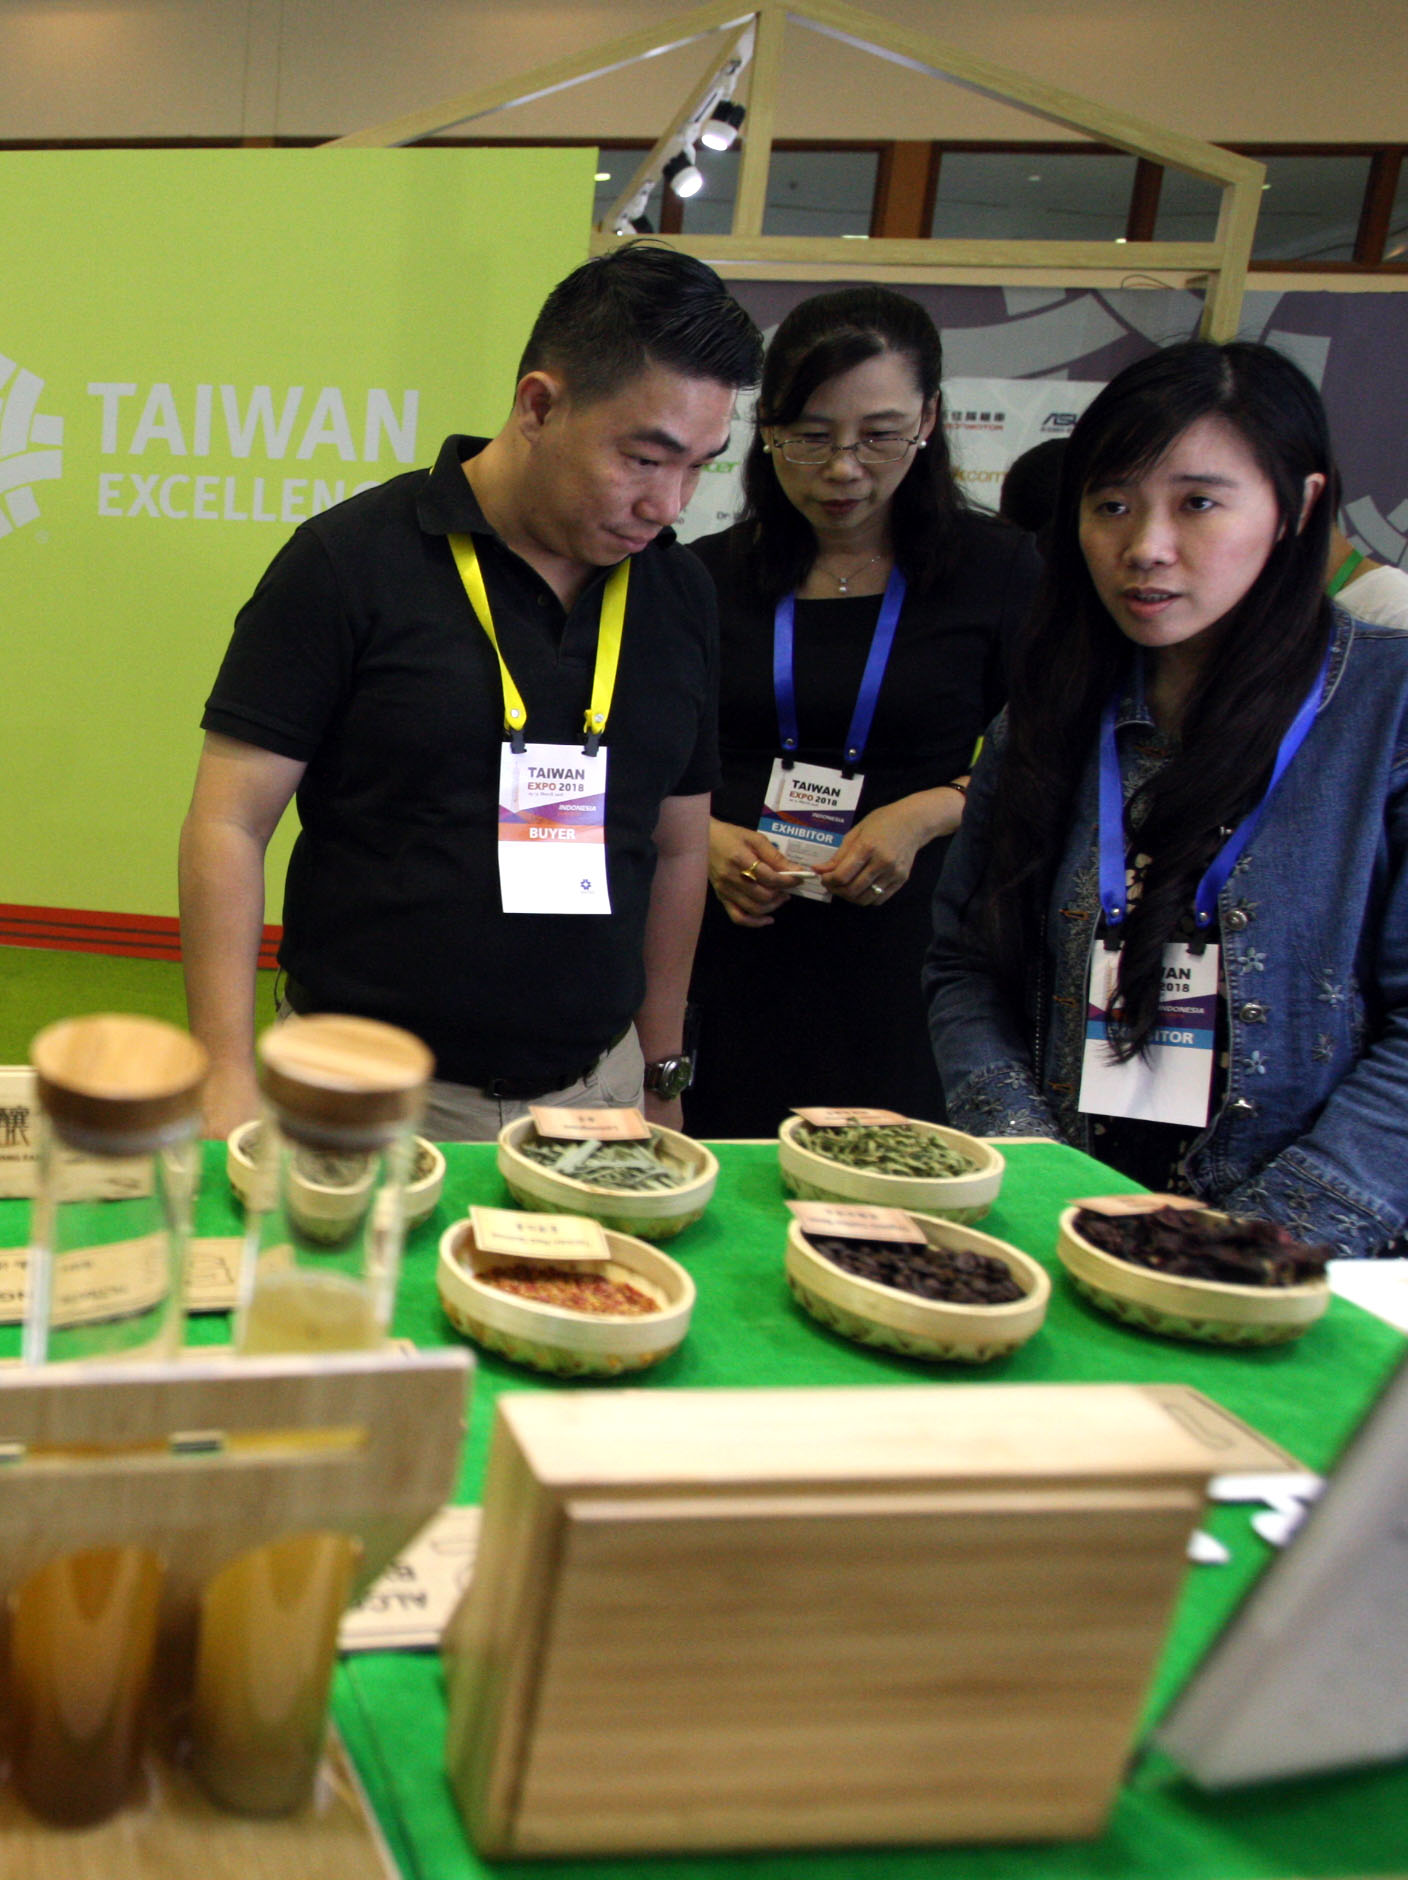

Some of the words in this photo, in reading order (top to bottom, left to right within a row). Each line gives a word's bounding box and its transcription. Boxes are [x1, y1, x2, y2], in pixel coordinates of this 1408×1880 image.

[87, 382, 419, 463] TAIWAN
[98, 472, 379, 523] EXCELLEN
[528, 766, 585, 780] TAIWAN
[527, 781, 556, 791] EXPO
[558, 782, 585, 792] 2018
[792, 779, 841, 798] TAIWAN
[789, 790, 814, 802] EXPO
[815, 795, 838, 807] 2018
[558, 804, 597, 812] INDONESIA
[529, 826, 577, 841] BUYER
[771, 821, 834, 844] EXHIBITOR
